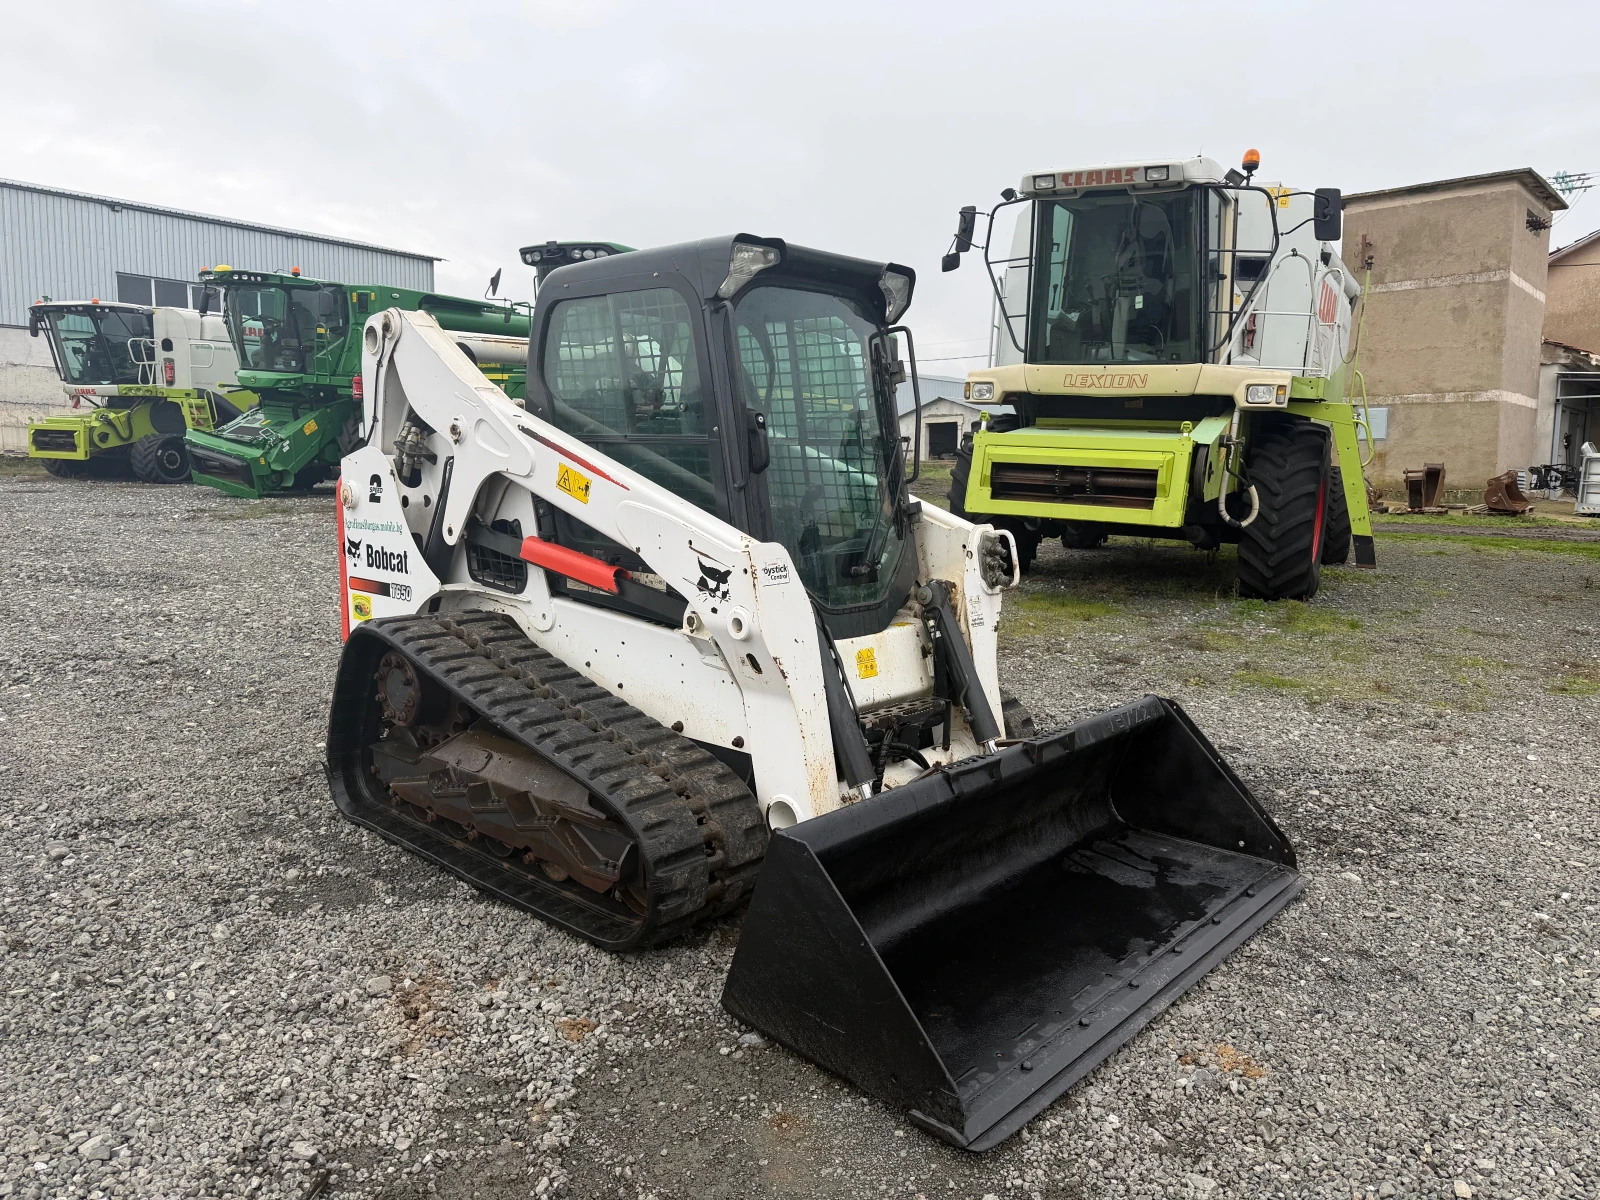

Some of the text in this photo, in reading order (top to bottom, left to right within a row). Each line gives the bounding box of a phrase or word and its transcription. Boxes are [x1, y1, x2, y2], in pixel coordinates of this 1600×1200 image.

[1061, 167, 1140, 187] CLAAS
[243, 327, 265, 337] LAA
[1063, 373, 1148, 389] LEXION
[369, 486, 383, 494] SPEED
[366, 543, 409, 575] Bobcat
[391, 582, 413, 602] T650
